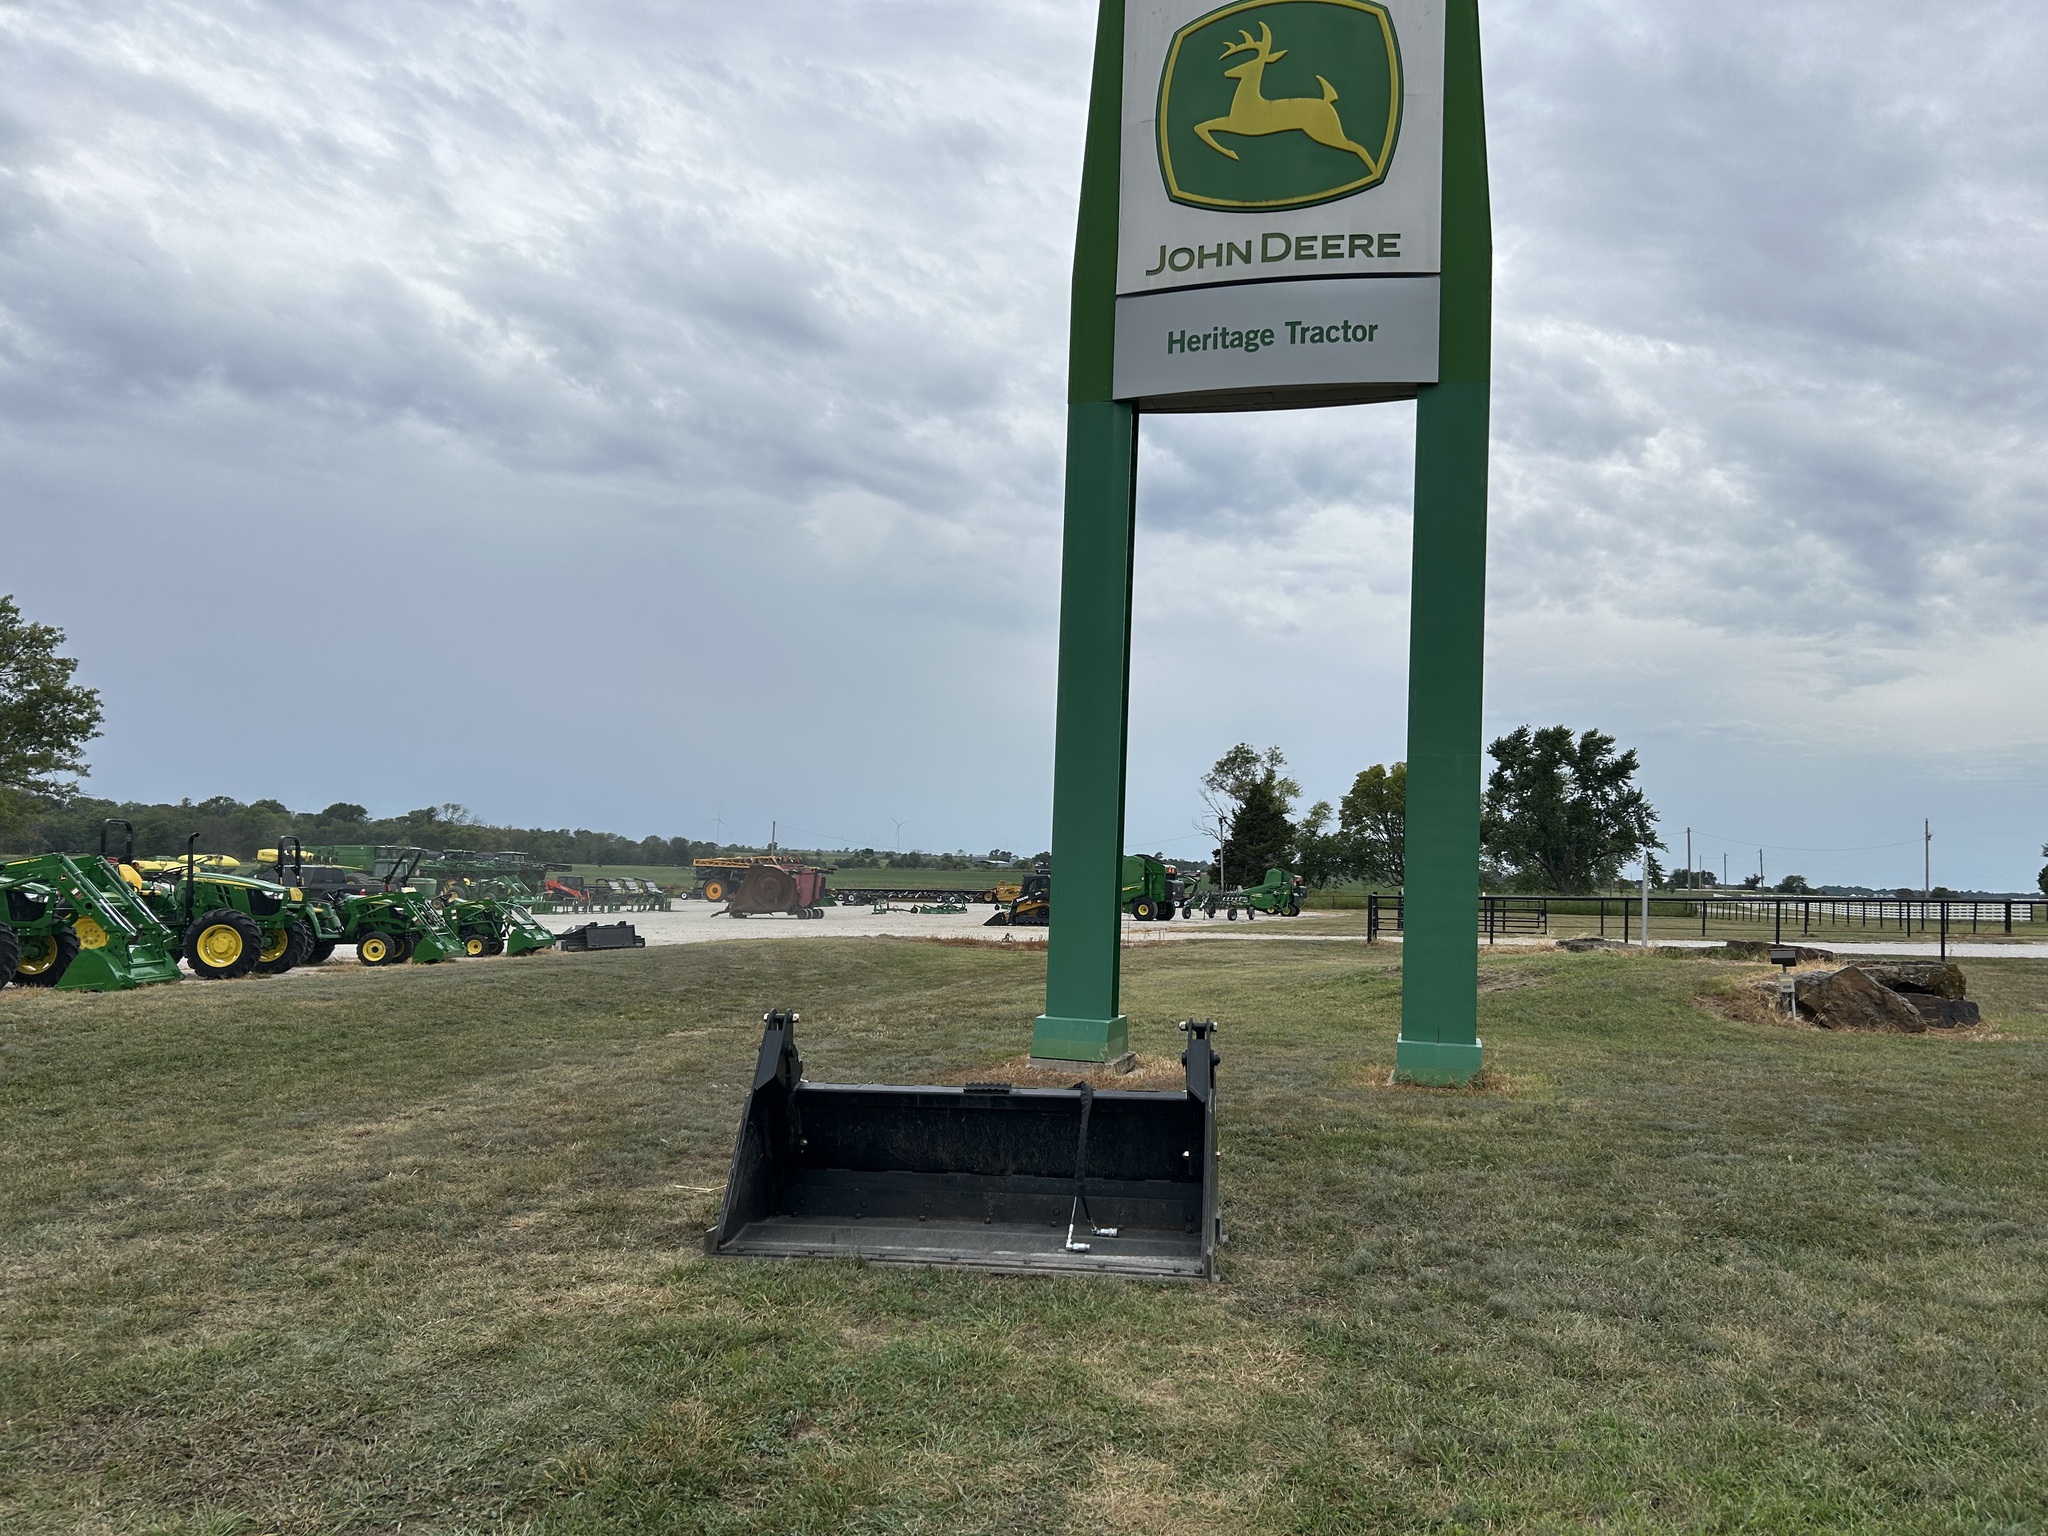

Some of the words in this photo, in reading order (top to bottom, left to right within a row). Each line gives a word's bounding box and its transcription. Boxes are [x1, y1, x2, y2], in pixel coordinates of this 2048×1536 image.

[1145, 240, 1252, 276] JOHN
[1261, 232, 1401, 263] DEERE
[1167, 326, 1275, 354] Heritage
[1284, 320, 1379, 345] Tractor
